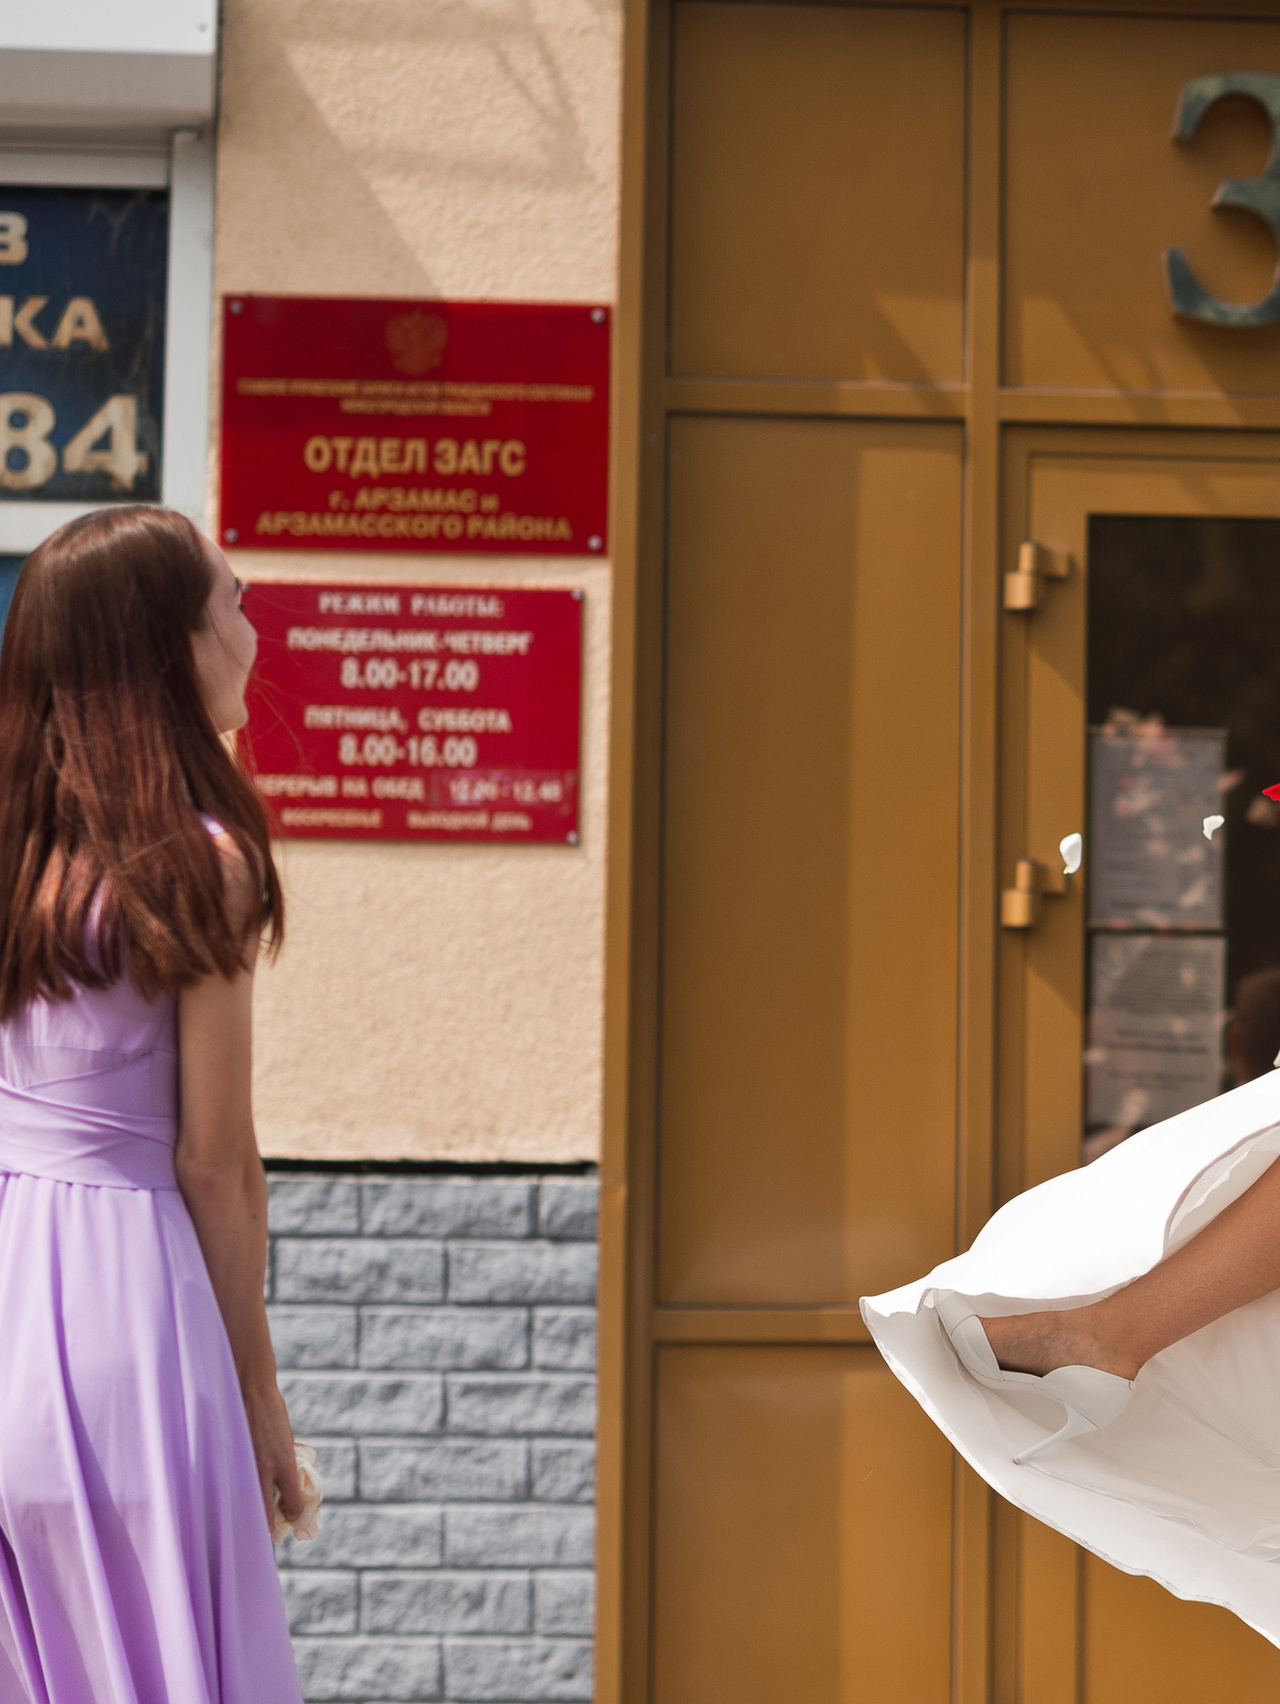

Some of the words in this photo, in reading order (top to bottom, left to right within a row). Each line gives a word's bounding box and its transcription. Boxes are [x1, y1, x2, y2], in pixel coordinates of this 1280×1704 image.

[304, 436, 428, 478] ОТДЕЛ
[433, 438, 526, 475] ЗАГС
[354, 487, 478, 513] АРЗАМАС
[480, 494, 500, 513] и
[255, 511, 464, 538] АРЗАМАССКОГО
[466, 514, 573, 541] РАЙОНА
[318, 592, 400, 615] РЕЖИМ
[287, 627, 533, 655] ПОНЕДЕЛЬНИК-ЧЕТВЕРГ
[340, 658, 479, 692] 8.00-17.00
[304, 706, 408, 735] ПЯТНИЦА,
[417, 708, 512, 733] СУББОТА
[338, 734, 478, 768] 8.00-16.00
[342, 775, 369, 798] НА
[372, 776, 425, 801] ОБЕД
